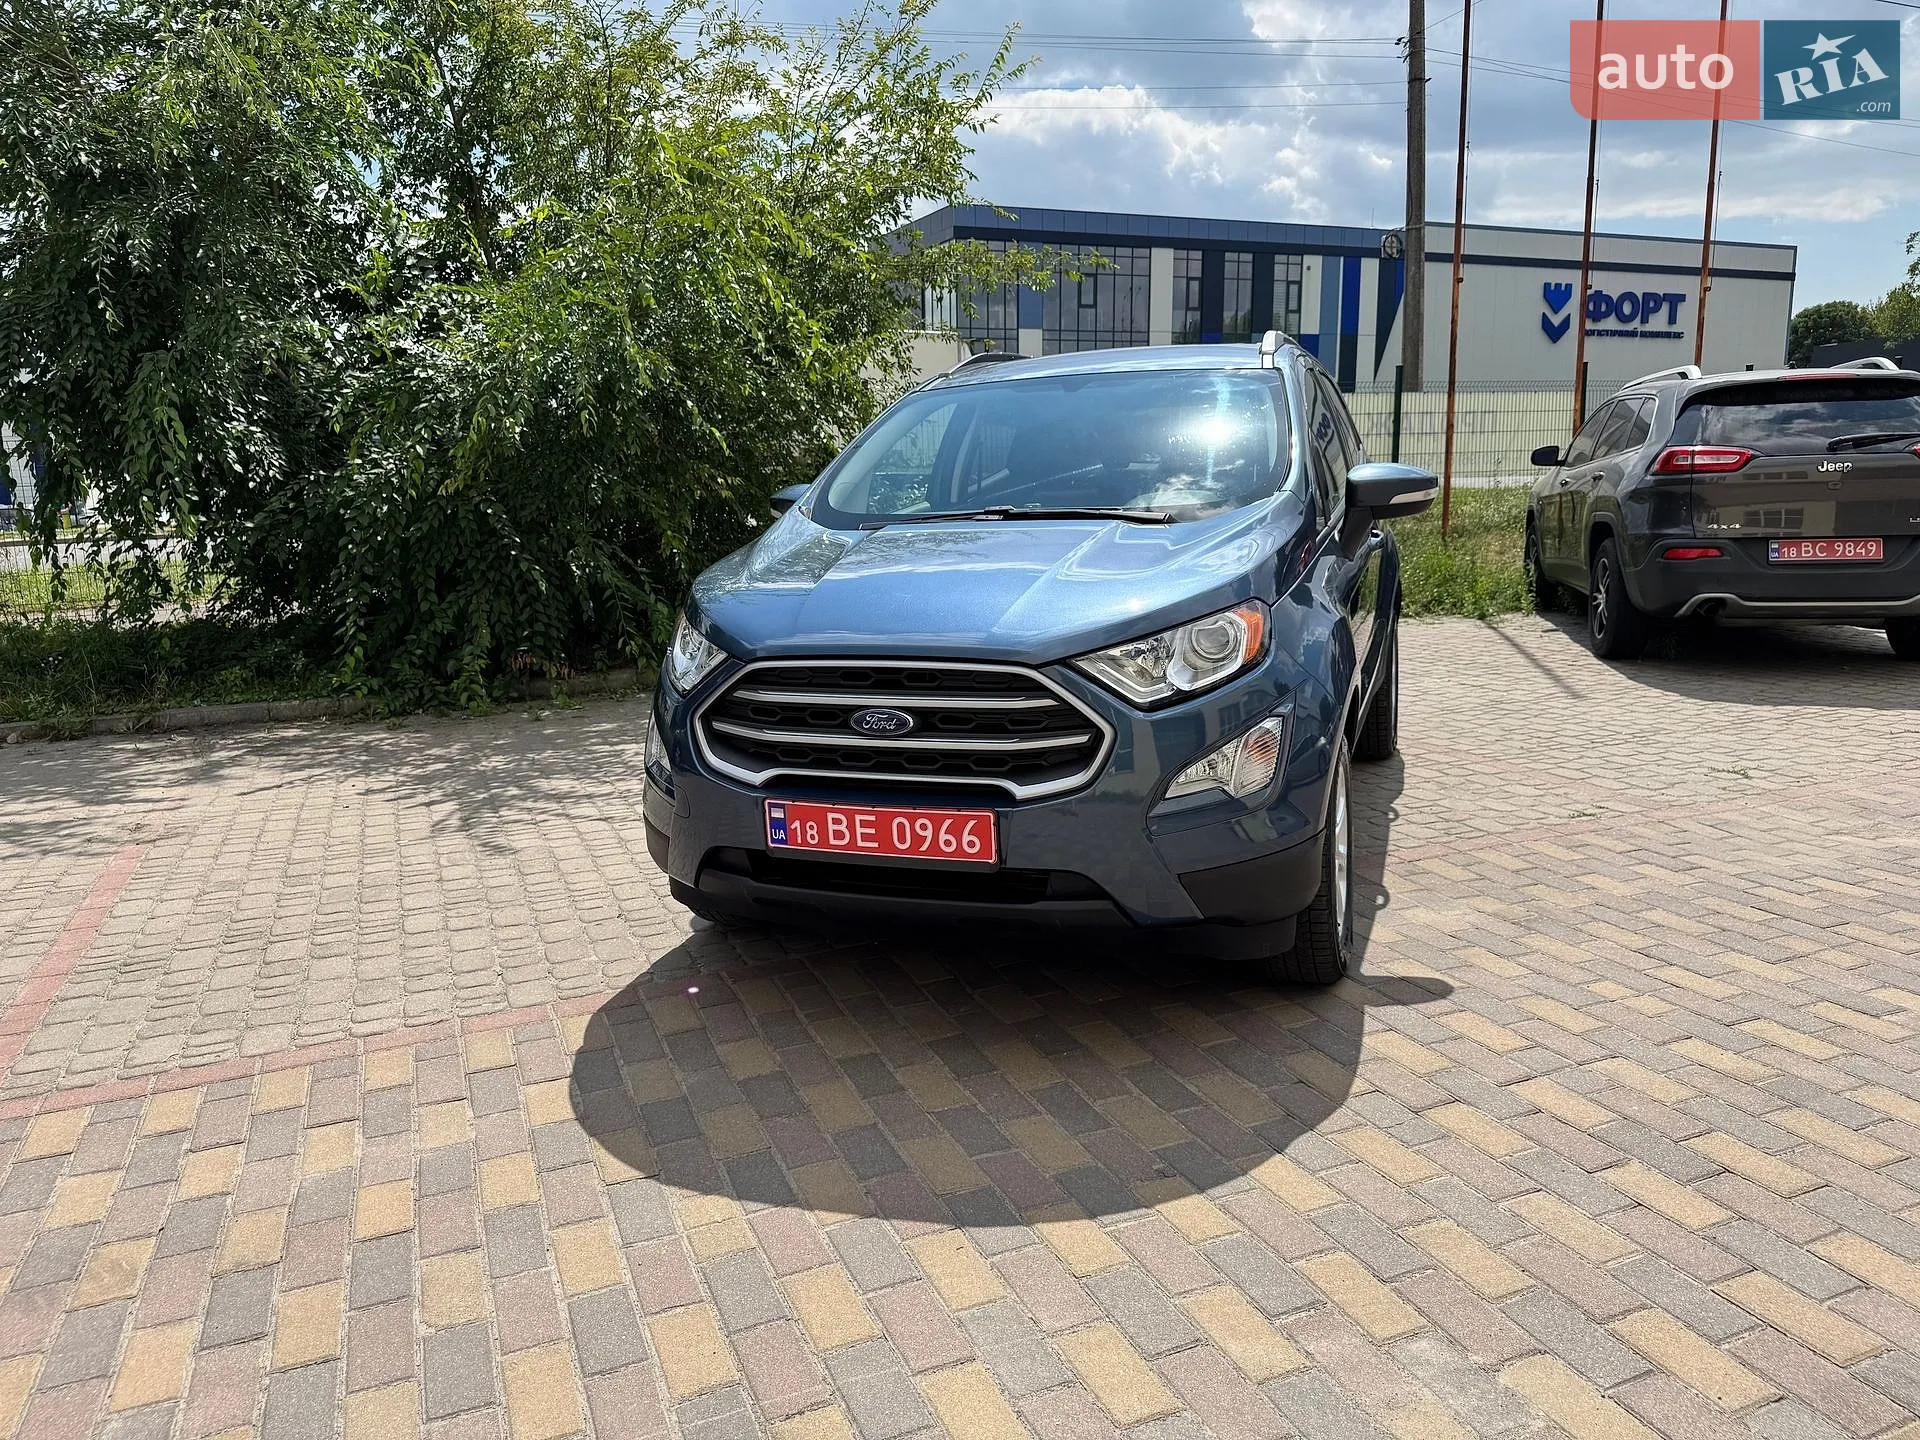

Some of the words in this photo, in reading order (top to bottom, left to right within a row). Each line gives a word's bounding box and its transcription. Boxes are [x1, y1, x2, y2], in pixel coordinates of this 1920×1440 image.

[1586, 290, 1686, 325] ФОРТ
[1817, 461, 1853, 473] Jeep
[1771, 551, 1780, 559] UA
[1781, 547, 1797, 558] 18
[1801, 542, 1827, 557] BC
[1834, 542, 1877, 557] 9849
[862, 714, 898, 730] Ford
[772, 828, 786, 840] UA
[790, 820, 819, 844] 18
[827, 812, 879, 848] BE
[891, 816, 981, 853] 0966
